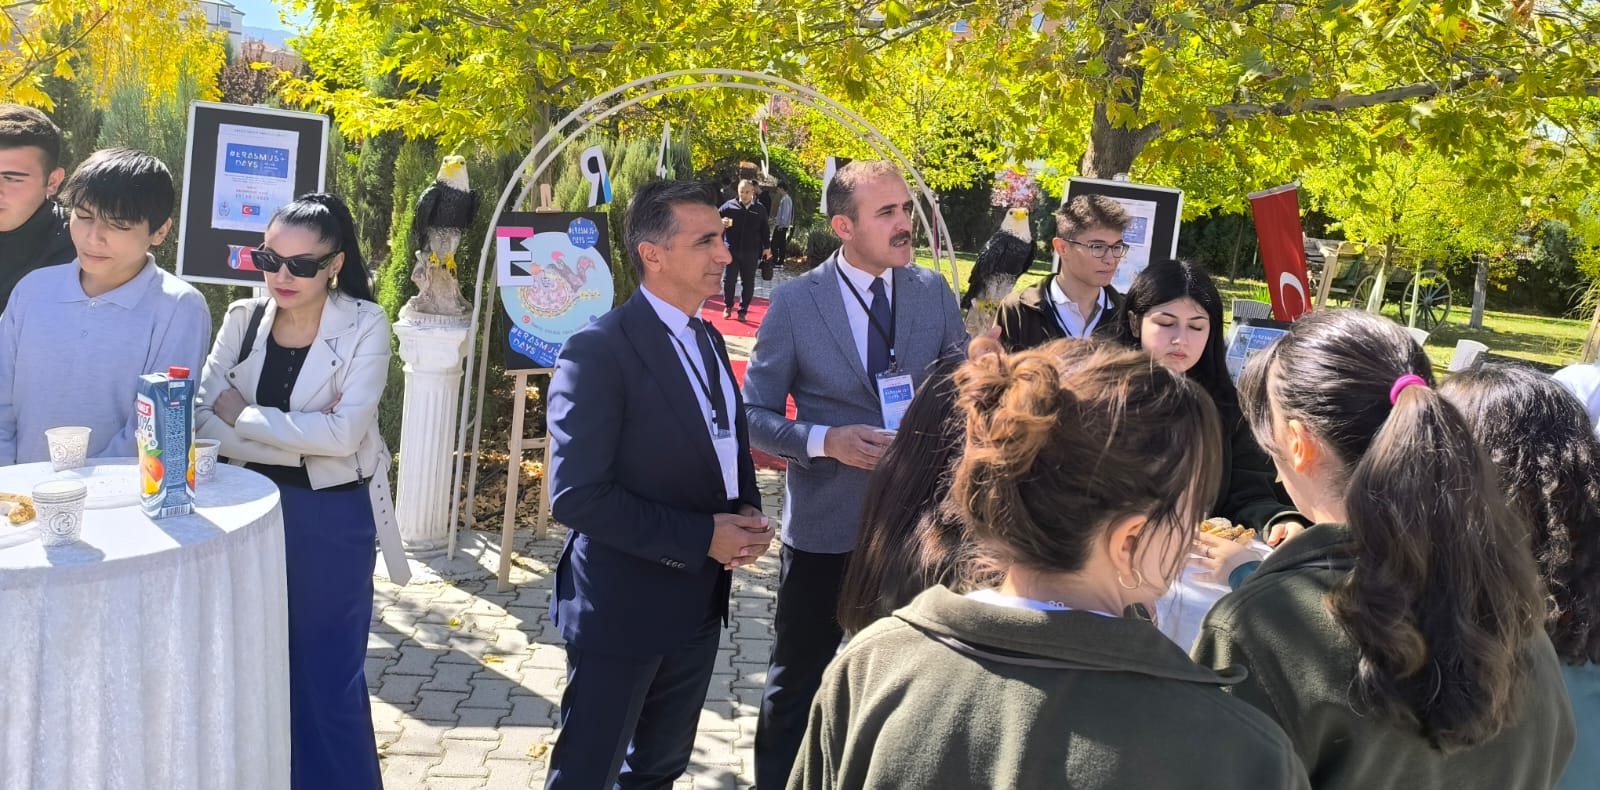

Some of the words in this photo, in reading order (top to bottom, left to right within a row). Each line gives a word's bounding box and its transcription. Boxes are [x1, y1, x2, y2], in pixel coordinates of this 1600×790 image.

[235, 159, 259, 169] DAYS
[496, 226, 534, 287] E
[513, 338, 537, 355] DAYS
